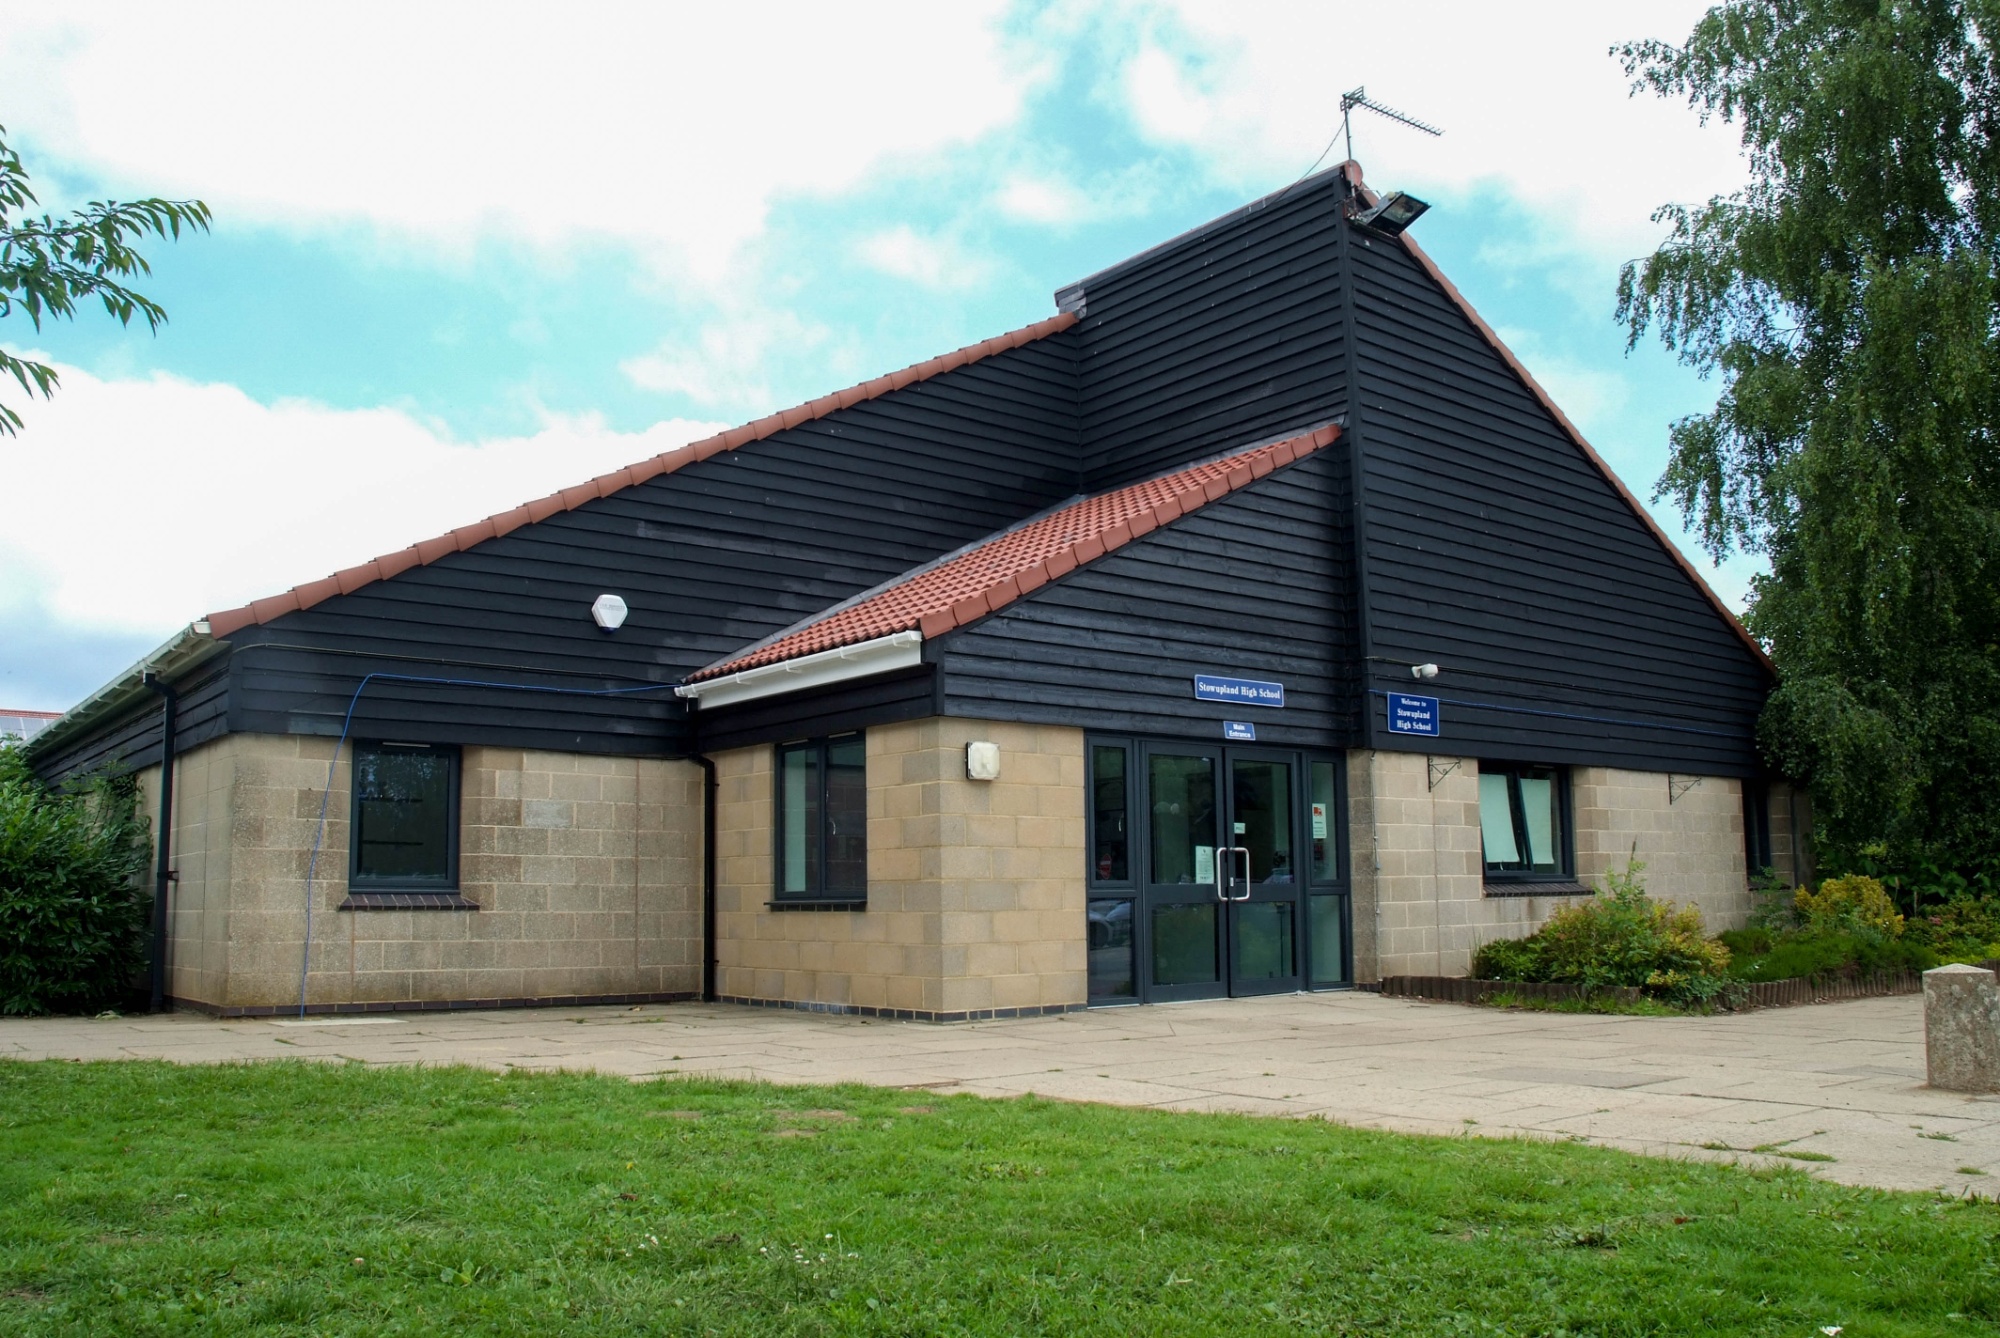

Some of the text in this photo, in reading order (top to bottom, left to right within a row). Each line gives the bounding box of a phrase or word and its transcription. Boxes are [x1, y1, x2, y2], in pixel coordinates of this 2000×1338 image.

[1198, 681, 1280, 699] Stowupland High School
[1401, 698, 1420, 706] Welcome
[1397, 708, 1430, 719] Stowupland
[1397, 720, 1431, 730] High School
[1228, 730, 1251, 738] Entrance
